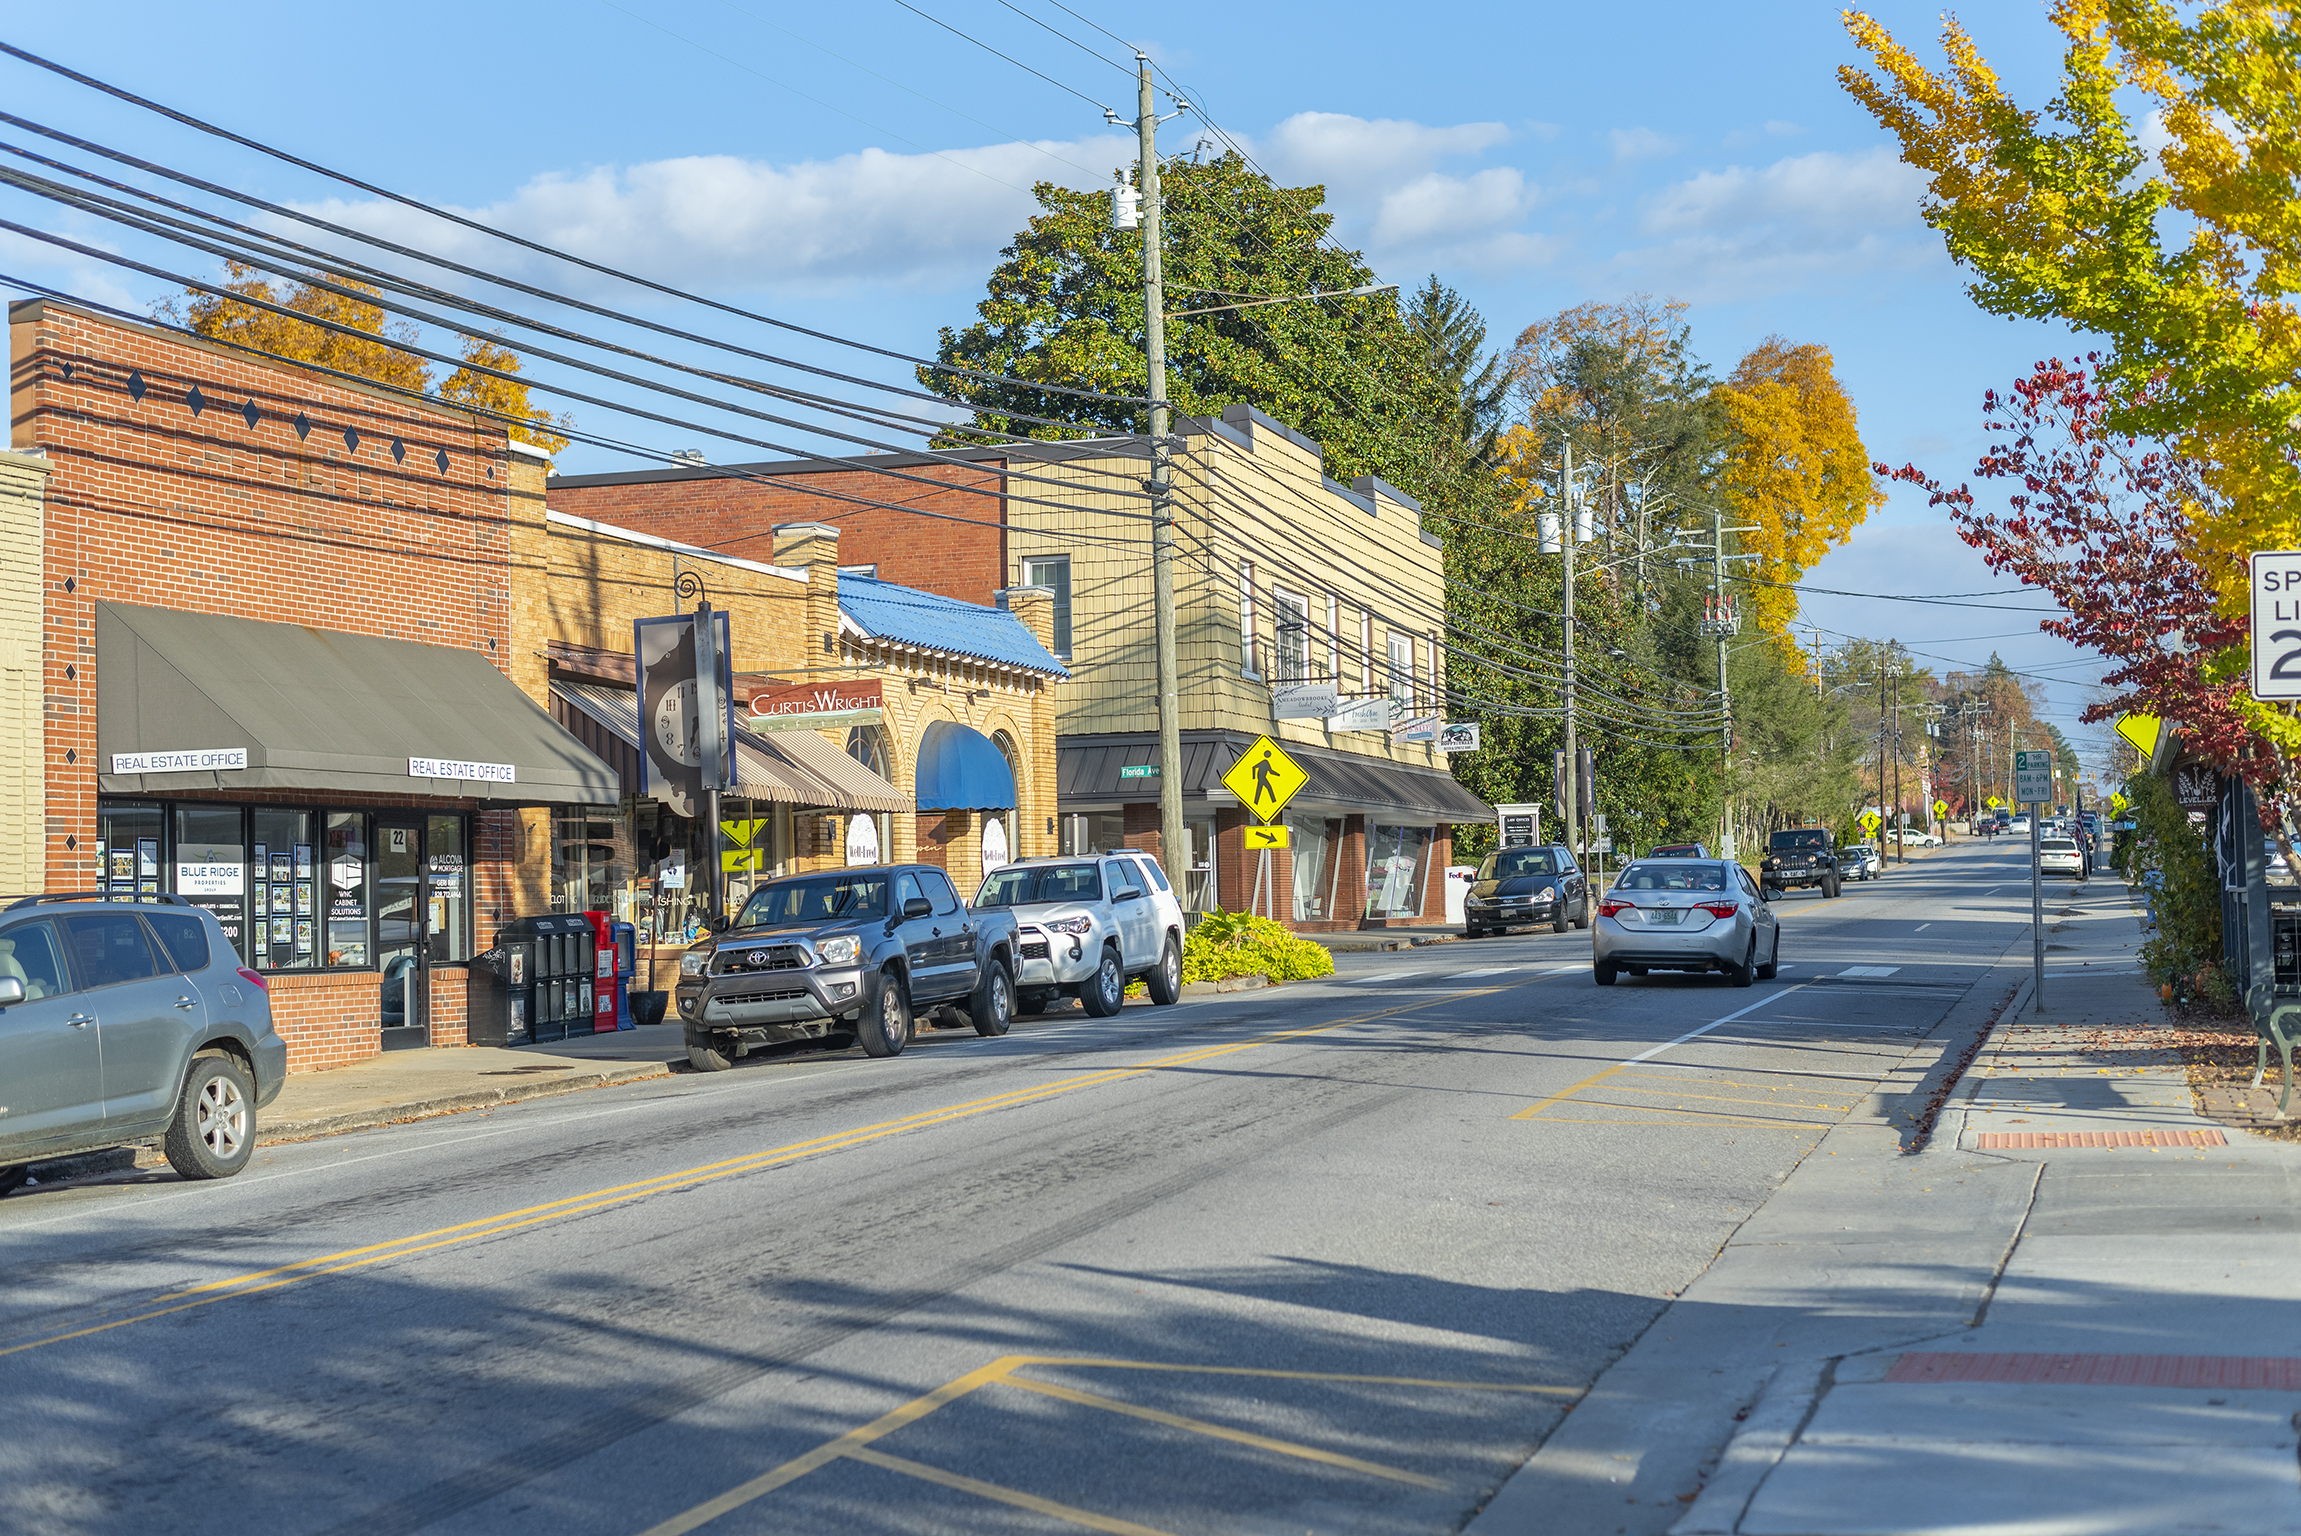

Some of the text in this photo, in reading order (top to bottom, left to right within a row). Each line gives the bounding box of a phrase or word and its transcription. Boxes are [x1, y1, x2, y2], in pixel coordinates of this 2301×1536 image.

[2269, 629, 2301, 680] 2
[666, 732, 674, 746] 8
[677, 744, 686, 757] 7
[116, 752, 243, 770] REAL ESTATE OFFICE
[2017, 755, 2026, 768] 2
[2027, 761, 2049, 769] PARKING
[412, 759, 512, 780] REAL ESTATE OFFICE
[1122, 767, 1160, 776] Florida Ave
[393, 830, 404, 845] 22
[438, 854, 463, 864] ALCOVA
[181, 867, 239, 877] BLUE RIDGE
[1448, 871, 1465, 879] FedE
[334, 899, 358, 907] CABINET
